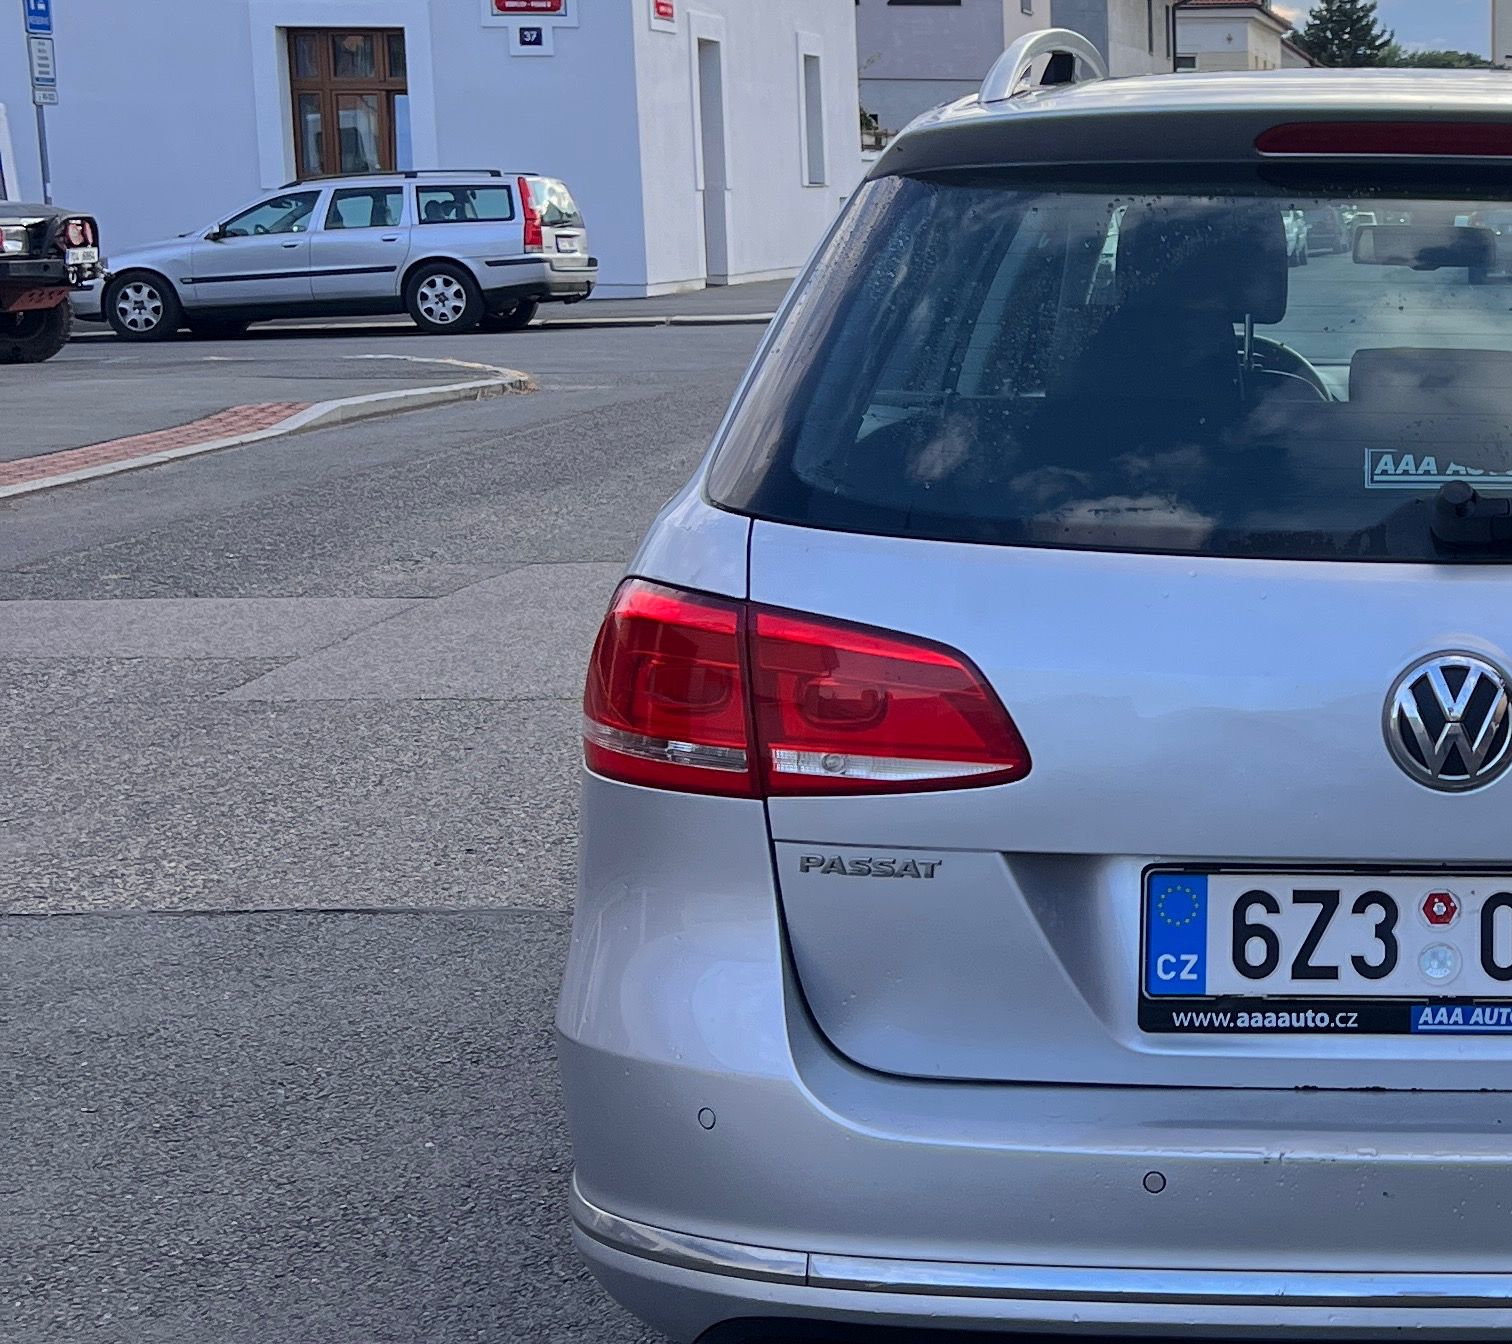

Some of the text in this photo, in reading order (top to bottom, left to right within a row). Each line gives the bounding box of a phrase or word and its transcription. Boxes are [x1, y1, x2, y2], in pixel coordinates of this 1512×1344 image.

[523, 30, 537, 42] 37
[1374, 454, 1438, 474] AAA
[799, 853, 942, 878] PASSAT
[1231, 889, 1399, 981] 6Z3
[1156, 953, 1198, 981] CZ
[1172, 1009, 1358, 1028] www.aaaauto.cz
[1418, 1007, 1463, 1025] AAA
